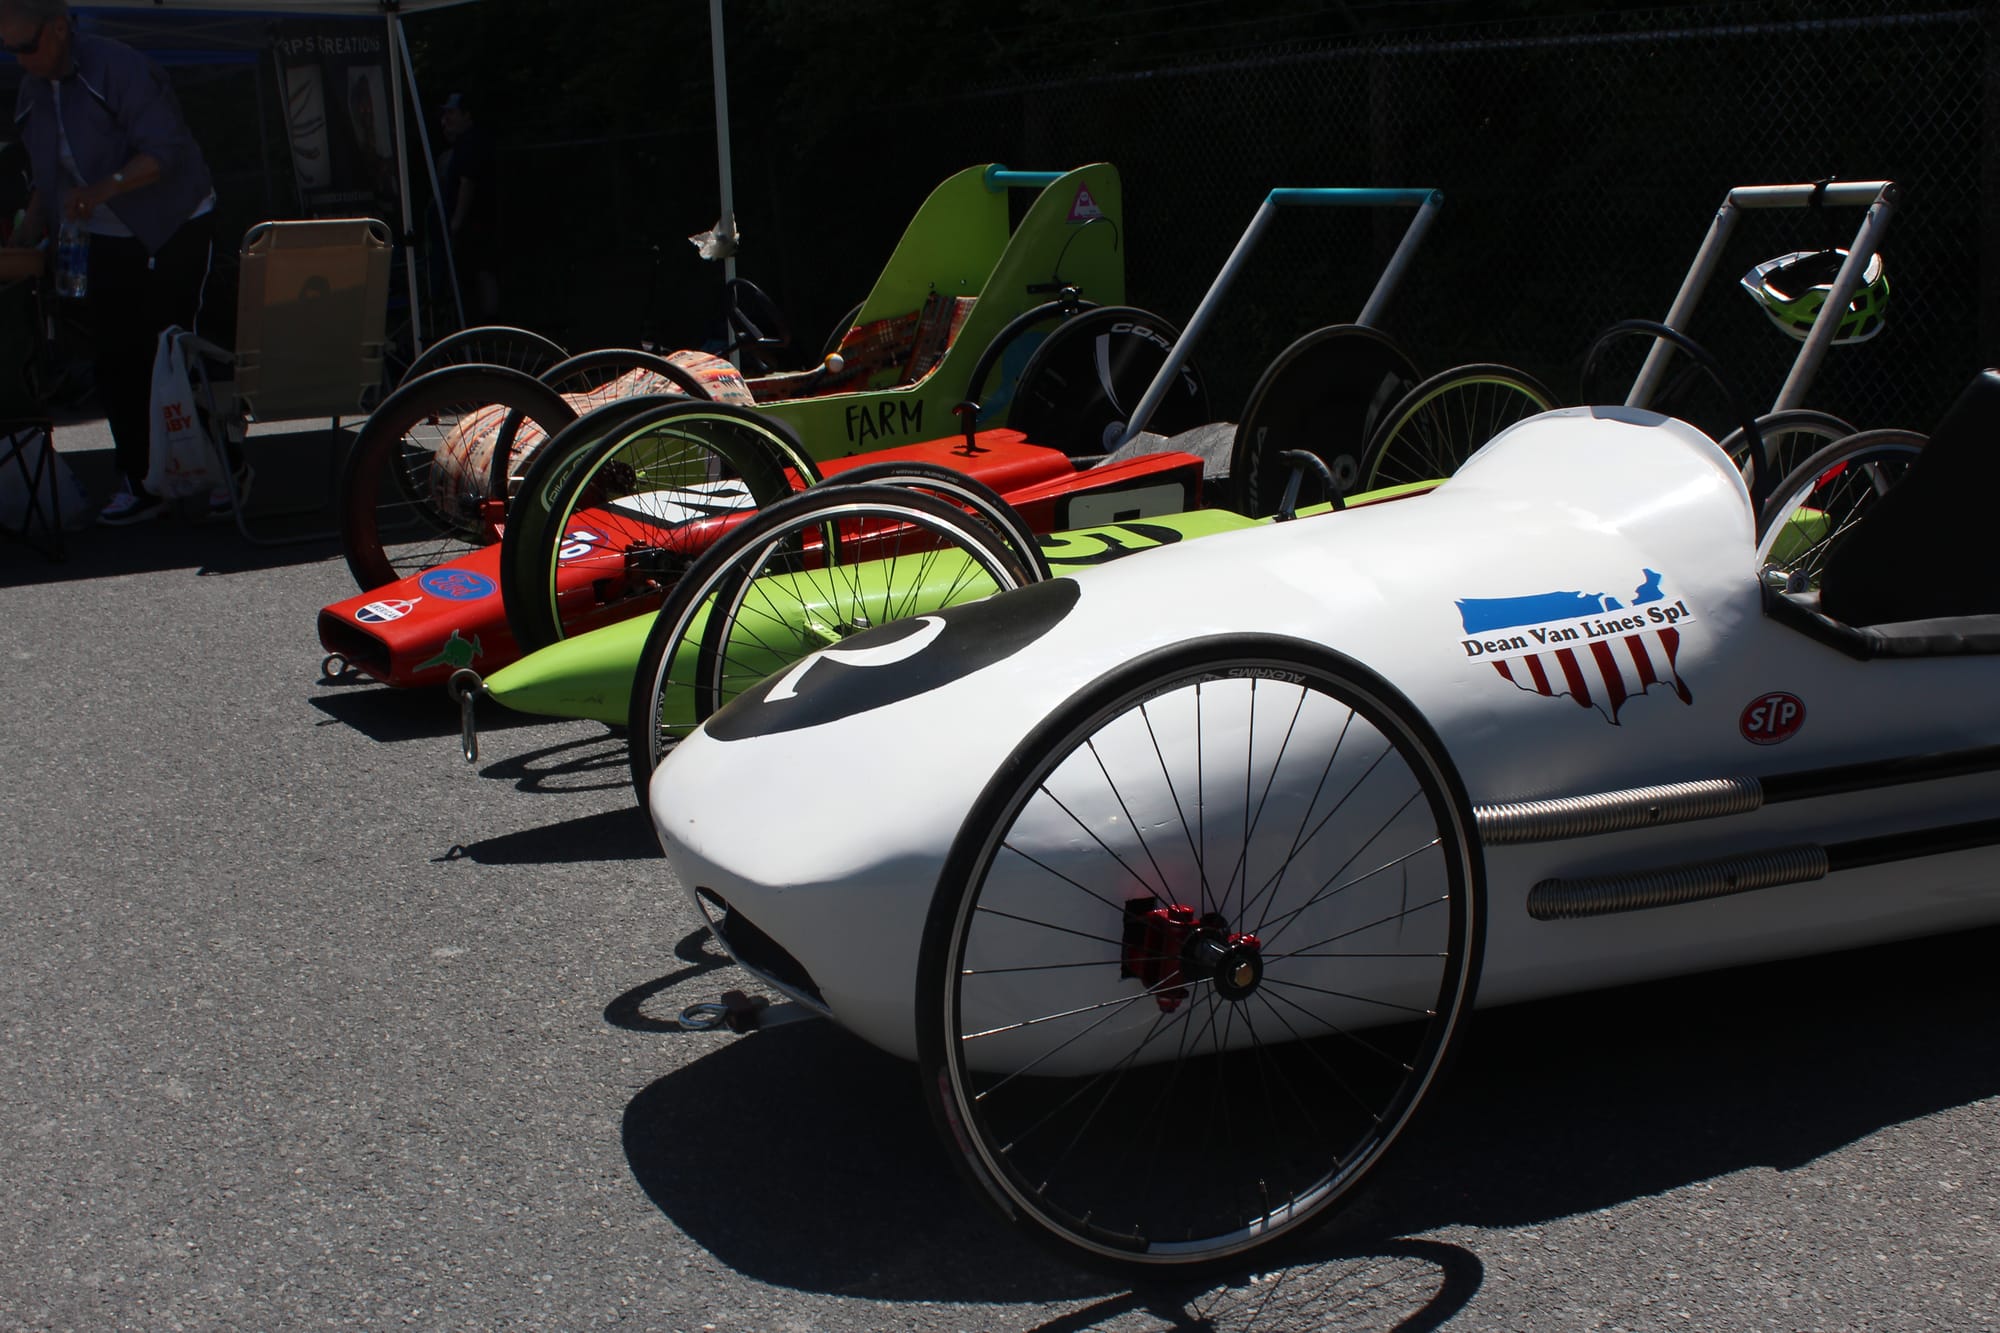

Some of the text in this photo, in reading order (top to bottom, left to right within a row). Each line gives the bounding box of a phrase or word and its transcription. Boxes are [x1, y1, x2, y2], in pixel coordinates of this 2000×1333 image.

[846, 400, 923, 445] FARM
[1461, 600, 1690, 657] Dean Van Lines Spl
[1228, 664, 1306, 683] ALEXRIMS
[1747, 697, 1797, 733] STP
